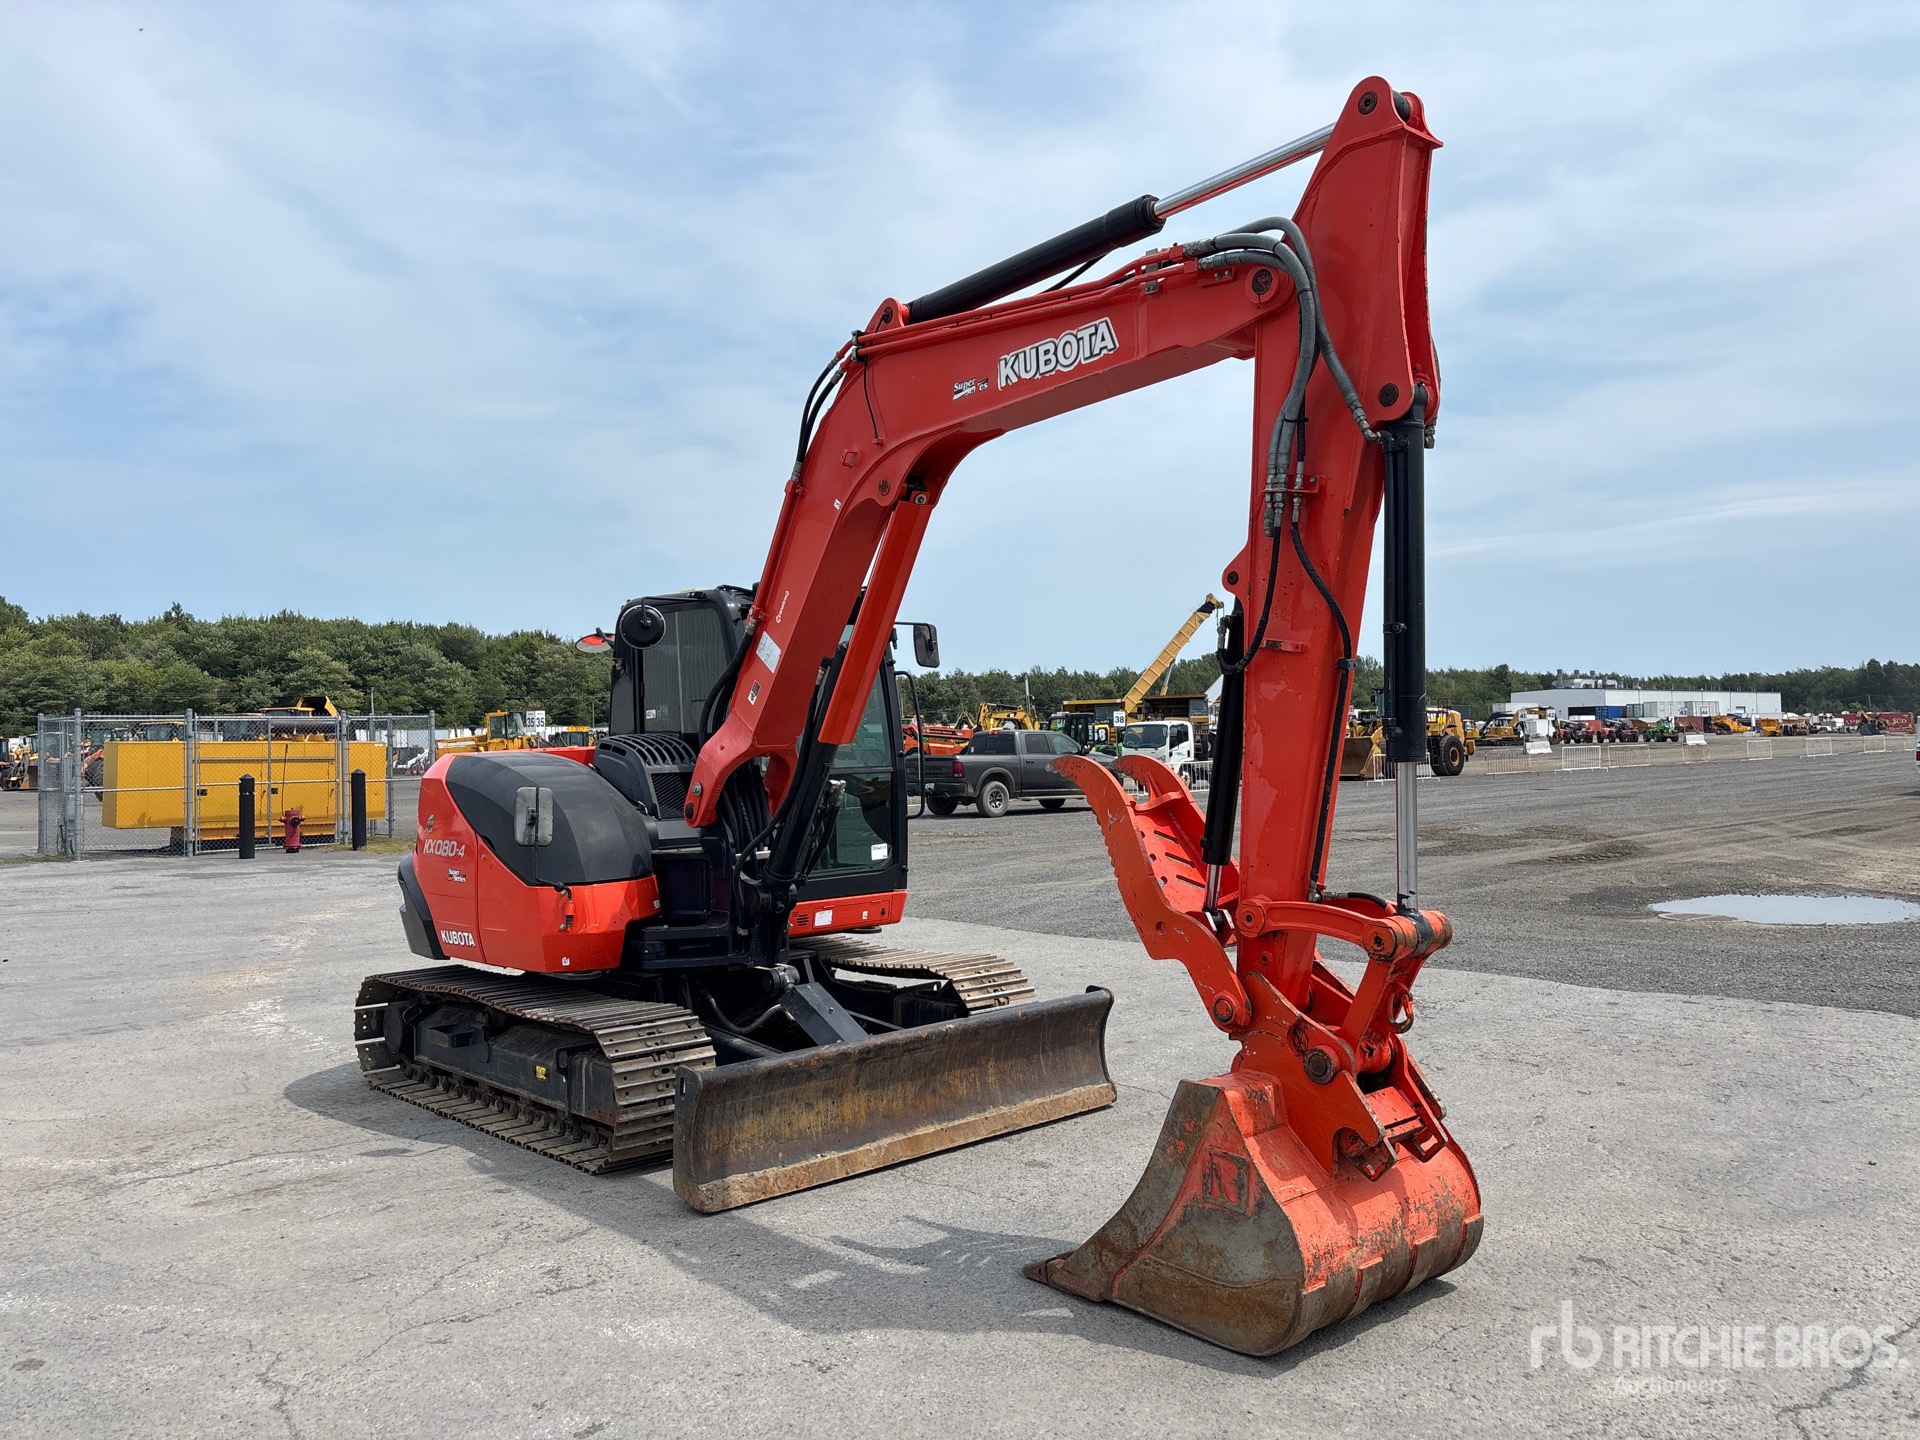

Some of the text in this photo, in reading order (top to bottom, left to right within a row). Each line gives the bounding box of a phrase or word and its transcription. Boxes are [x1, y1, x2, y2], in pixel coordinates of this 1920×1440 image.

[998, 317, 1119, 390] KUBOTA
[953, 379, 976, 392] Super
[526, 717, 535, 728] 35
[536, 717, 545, 728] 35
[1114, 715, 1125, 724] 38
[424, 839, 465, 857] KX080-4
[440, 930, 476, 947] KUBOTA
